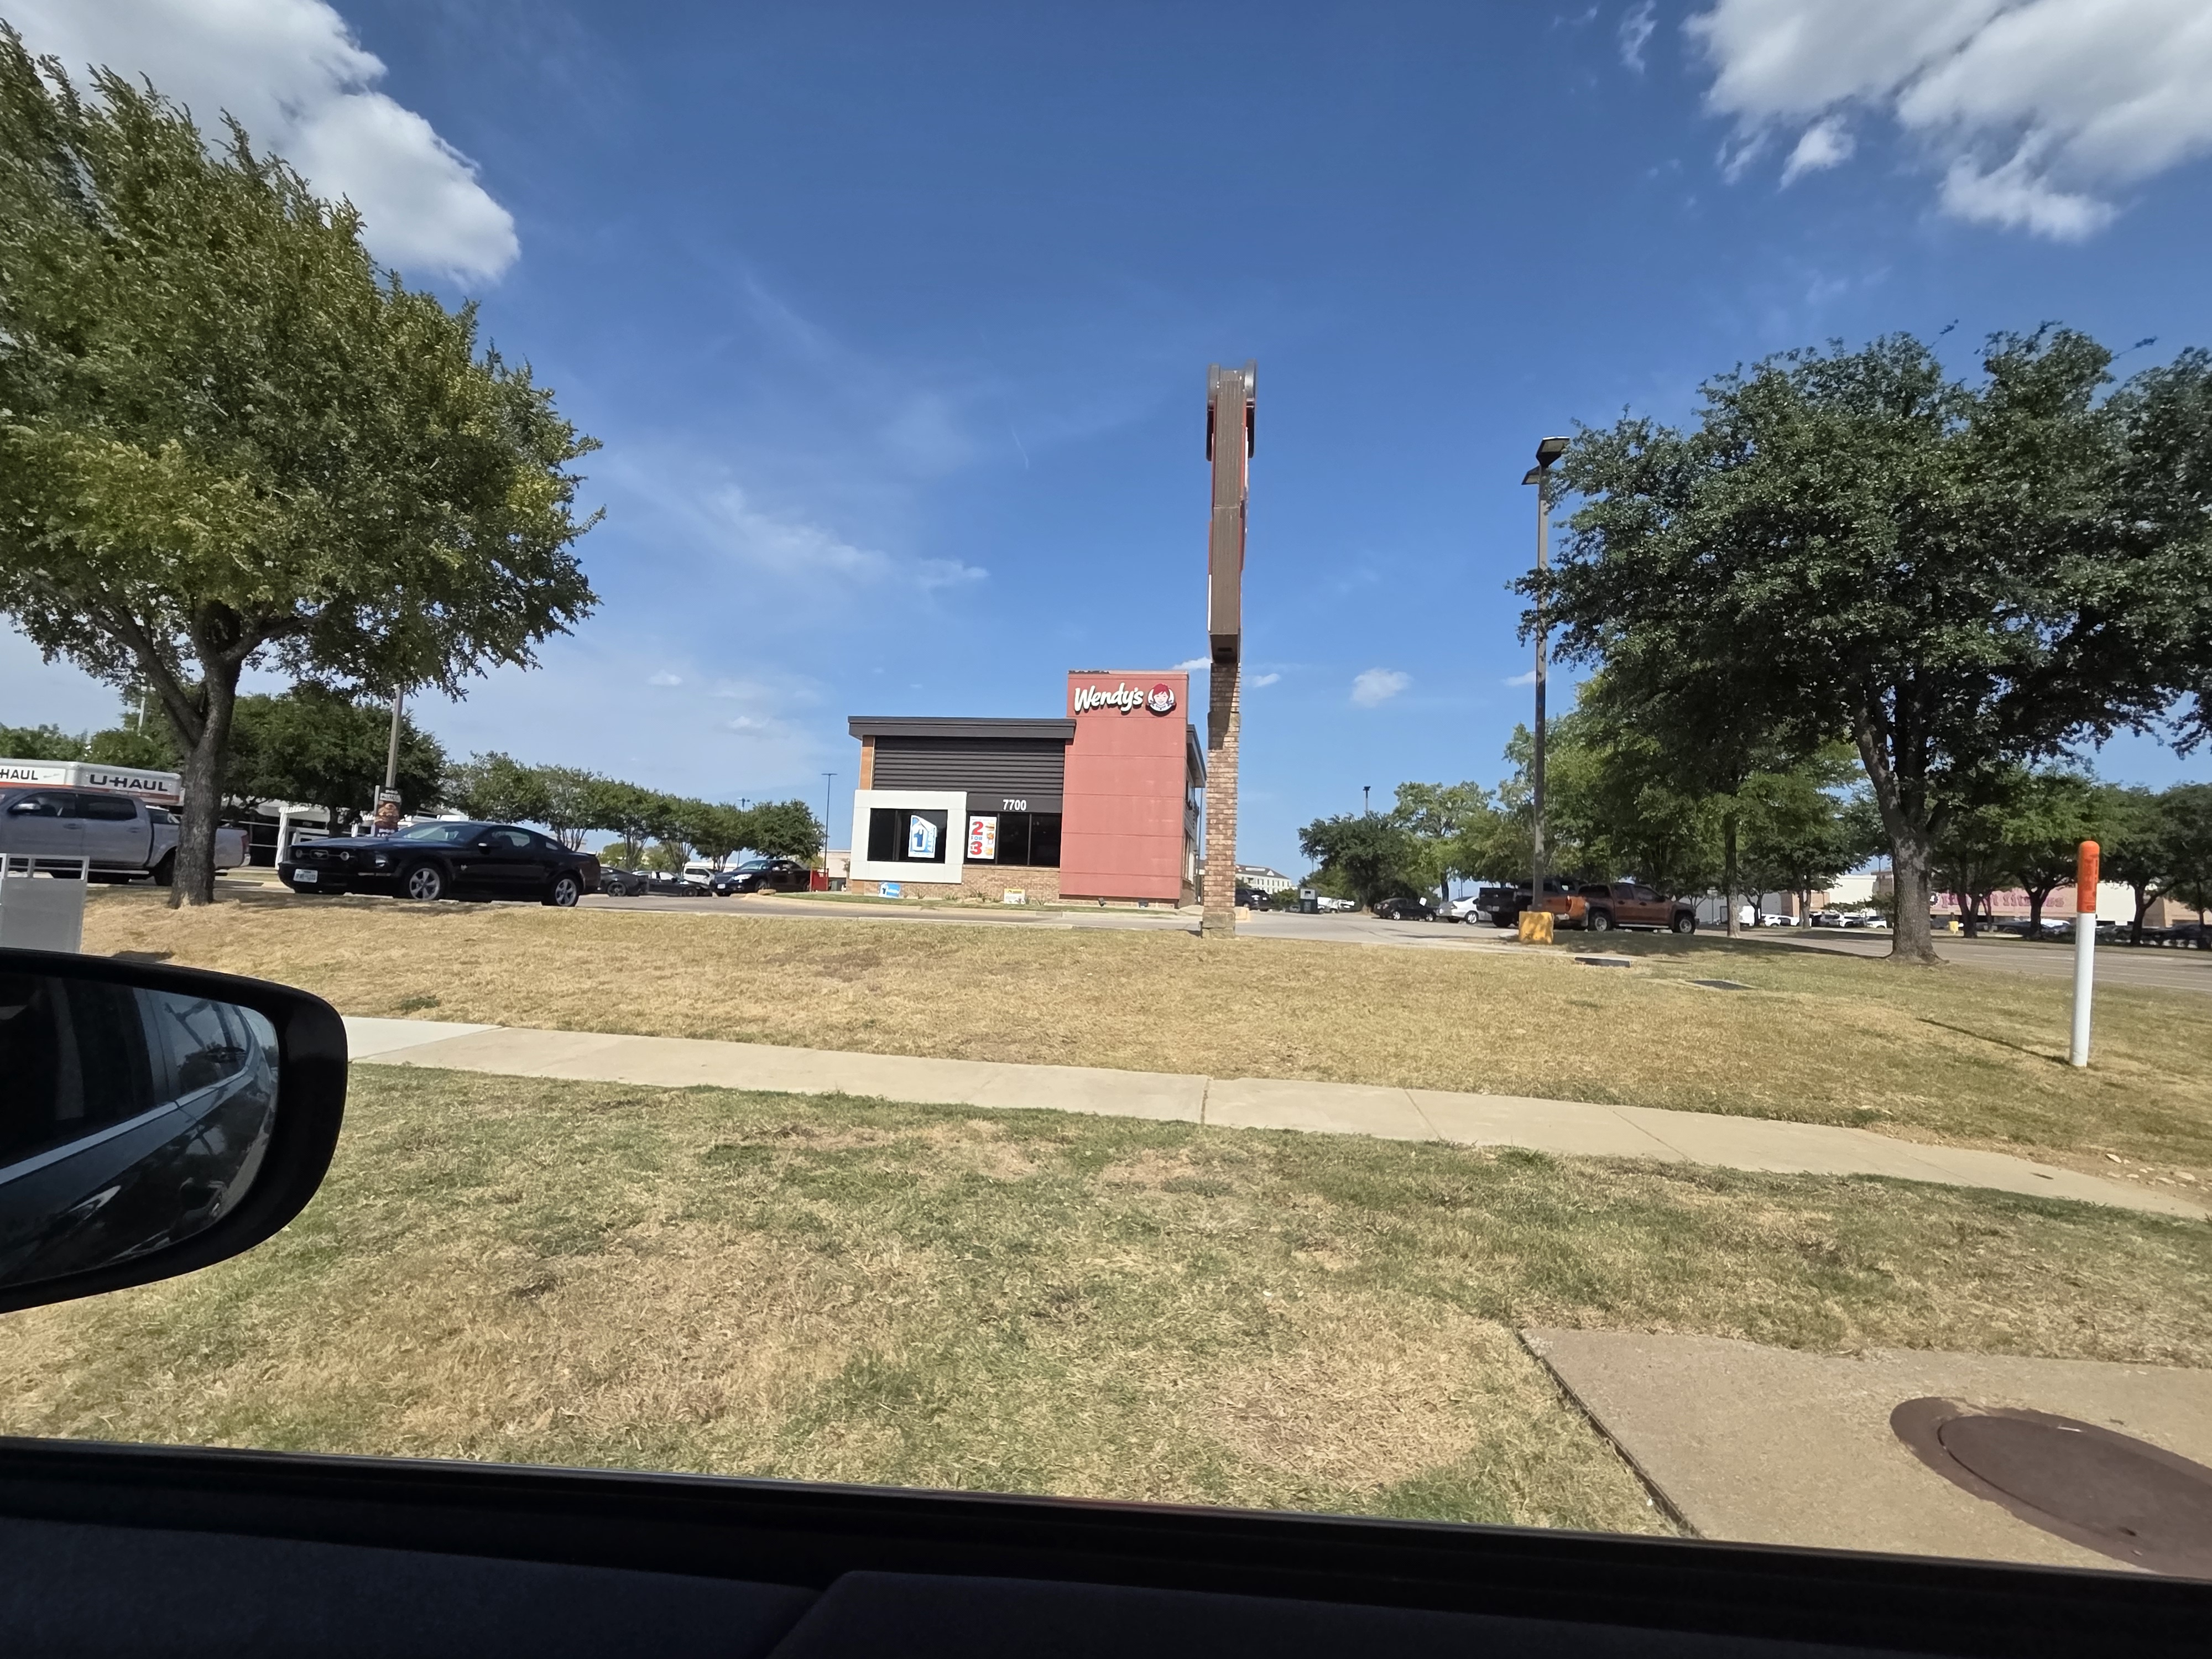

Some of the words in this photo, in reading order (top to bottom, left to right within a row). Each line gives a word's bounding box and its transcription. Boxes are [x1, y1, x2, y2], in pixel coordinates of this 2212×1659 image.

[1074, 682, 1143, 712] Wendy's
[0, 769, 38, 780] HAUL
[90, 774, 168, 791] U-HAUL
[1003, 799, 1026, 811] 7700
[972, 821, 983, 835] 2
